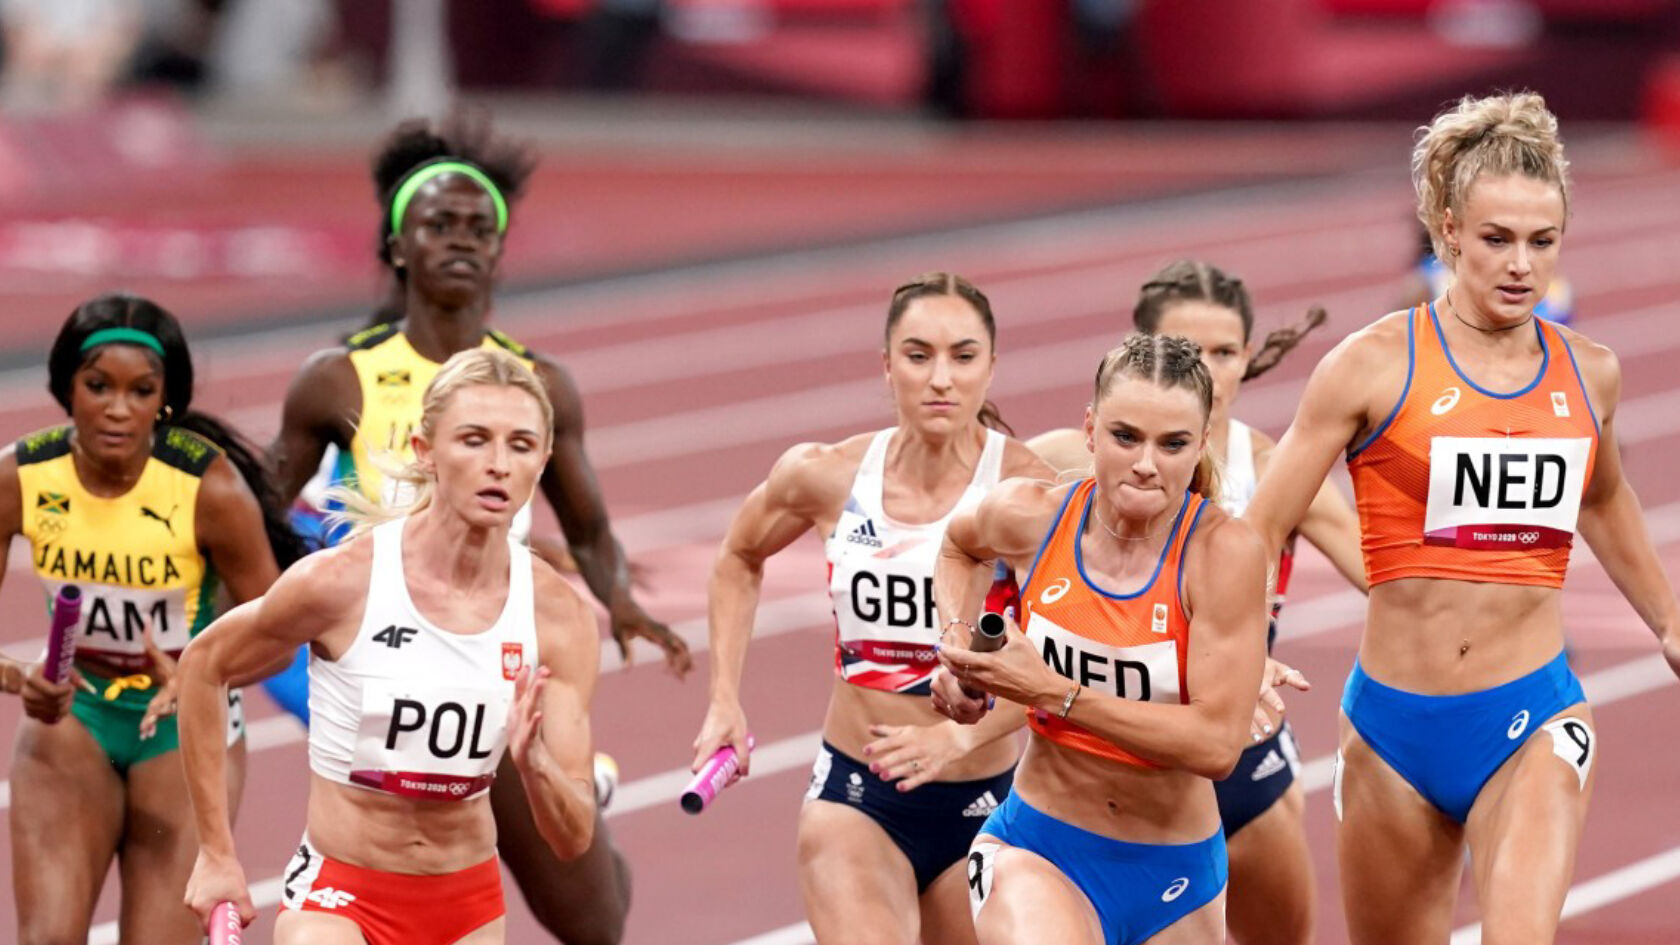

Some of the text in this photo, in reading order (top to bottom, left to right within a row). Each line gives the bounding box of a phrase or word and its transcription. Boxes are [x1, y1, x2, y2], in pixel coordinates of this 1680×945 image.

[1453, 453, 1567, 510] NED
[847, 534, 883, 548] adidas
[1473, 532, 1517, 543] TOKYO 2020
[36, 543, 180, 586] JAMAICA
[85, 597, 169, 641] AM
[372, 625, 418, 649] 4F
[385, 698, 493, 760] POL
[1563, 721, 1590, 768] 9
[400, 779, 447, 793] TOKYO 2020
[307, 886, 356, 909] 4F
[967, 851, 985, 902] 9
